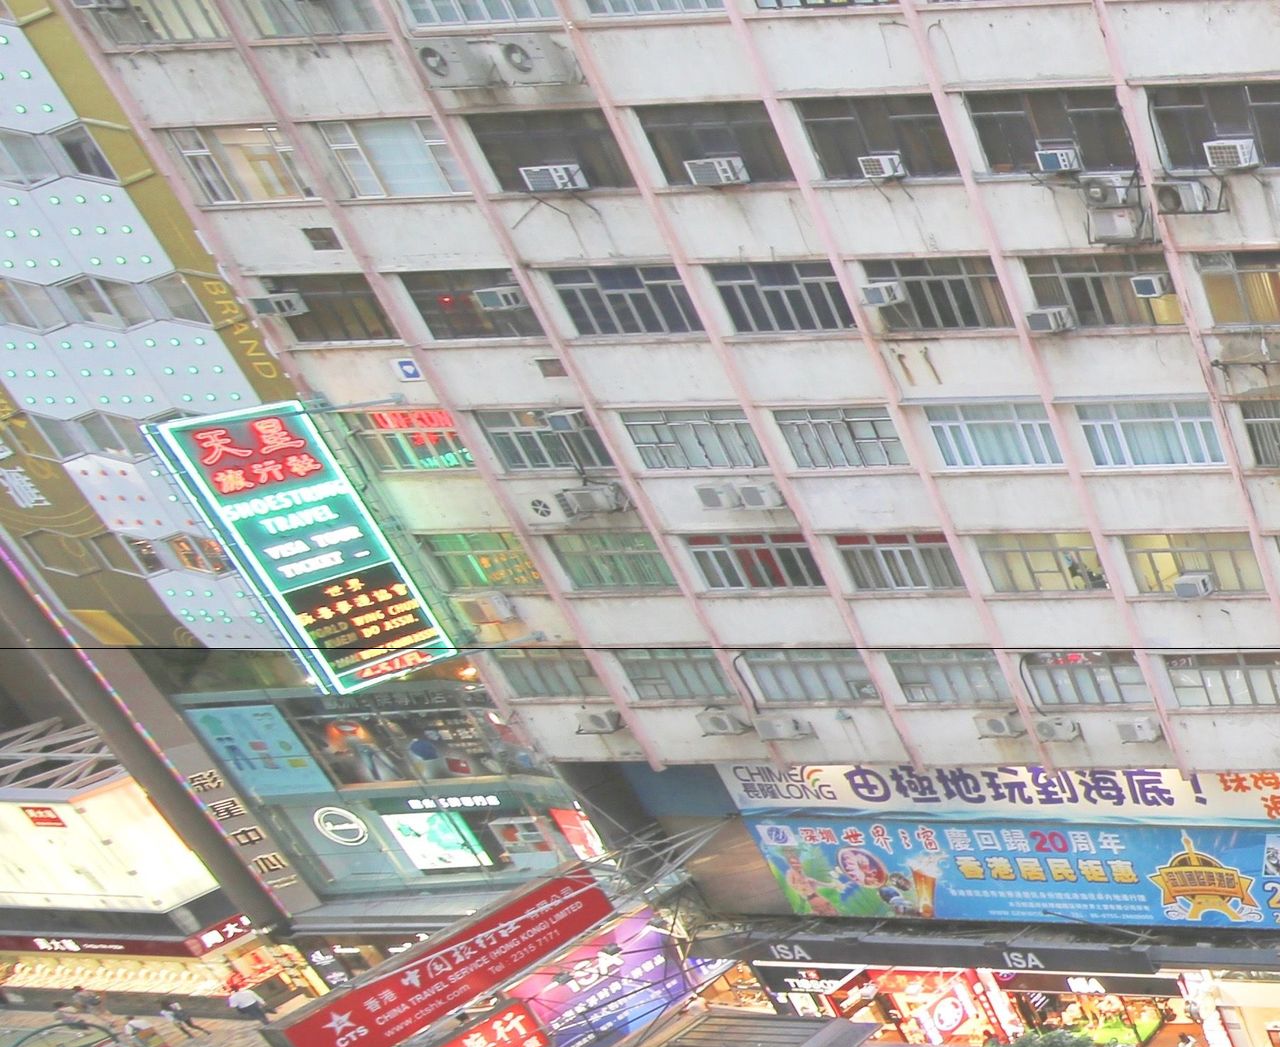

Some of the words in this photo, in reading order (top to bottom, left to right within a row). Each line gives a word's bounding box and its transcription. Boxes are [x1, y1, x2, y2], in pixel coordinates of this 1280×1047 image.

[202, 280, 279, 381] BRAND
[194, 416, 305, 465] 天星
[213, 453, 323, 494] 旅行社
[259, 504, 340, 534] TRAVEL
[263, 539, 310, 559] VISA
[310, 526, 364, 548] TOUR
[278, 550, 345, 578] TICKET
[776, 784, 837, 801] LONG
[945, 828, 1127, 856] 慶回歸20周年
[511, 944, 537, 963] 2315
[534, 929, 562, 948] 7171
[770, 944, 812, 961] ISA
[1003, 951, 1045, 969] ISA
[375, 1007, 409, 1027] CHINA
[408, 984, 449, 1010] TRAVEL
[448, 958, 491, 986] SERVICE
[490, 938, 521, 962] (HONG
[519, 921, 549, 946] KONG)
[548, 900, 584, 927] LIMITED
[362, 988, 398, 1015] 香港
[383, 983, 471, 1038] www.ctshk.com
